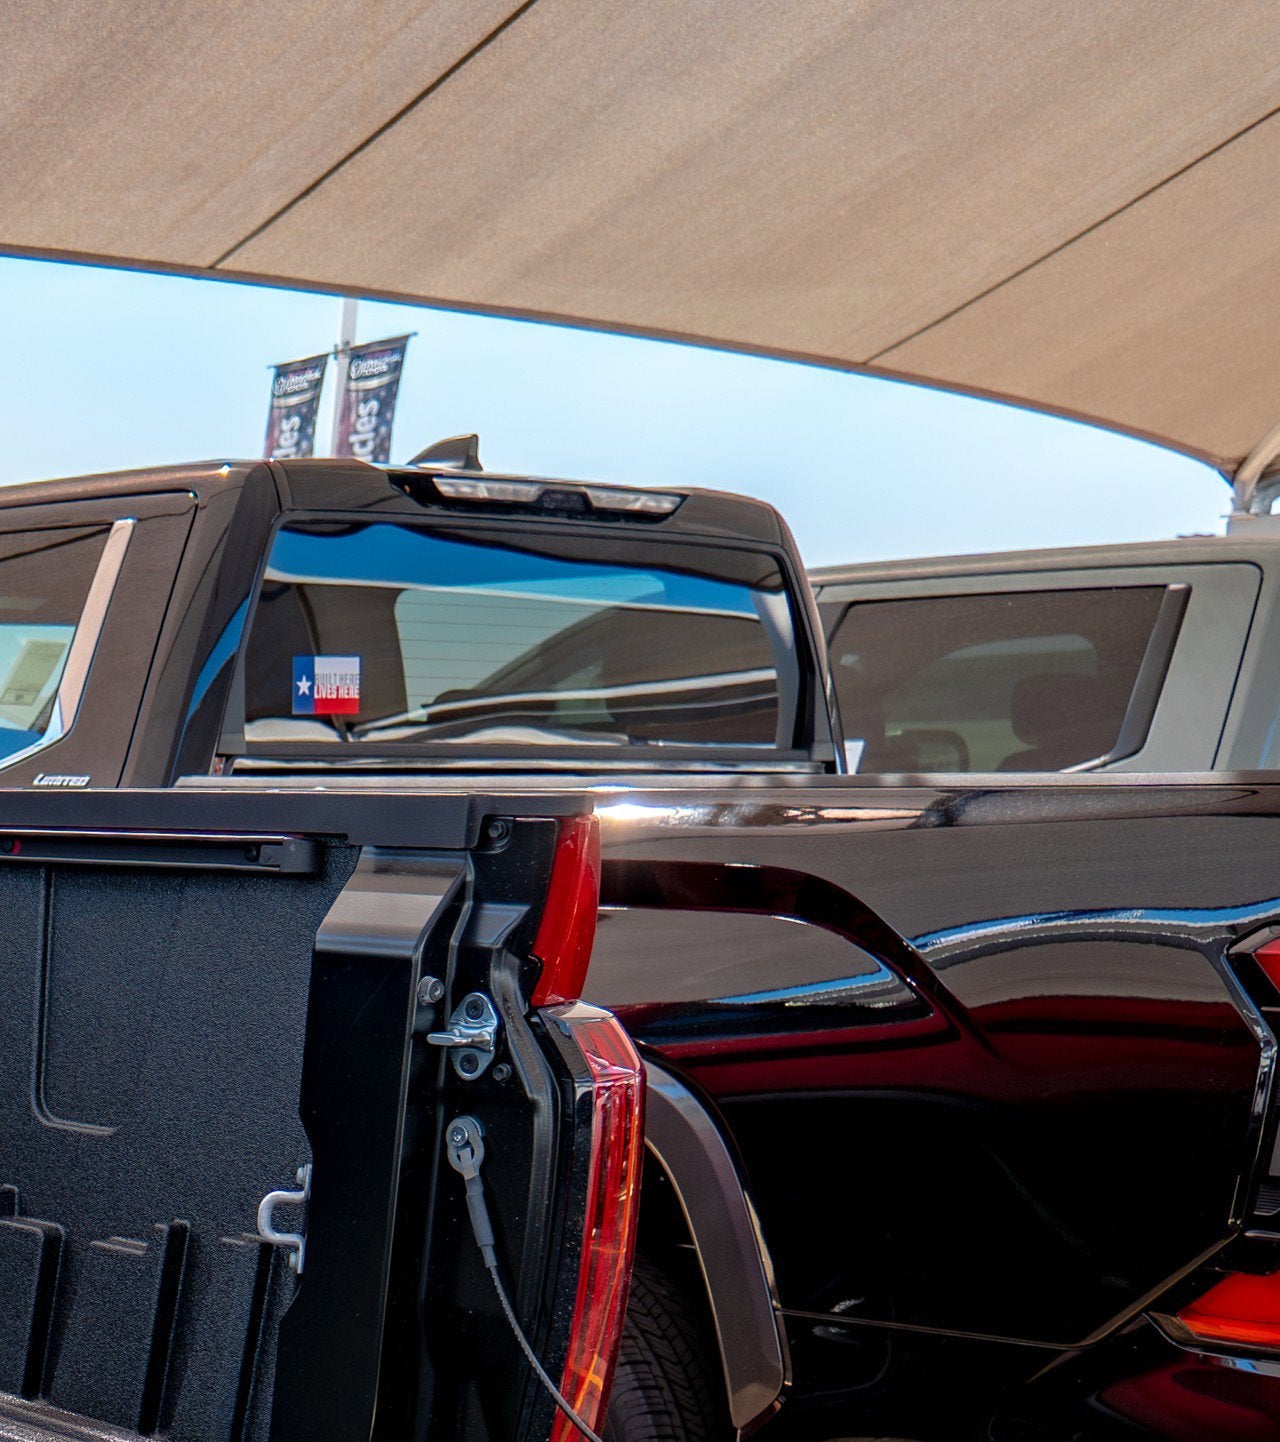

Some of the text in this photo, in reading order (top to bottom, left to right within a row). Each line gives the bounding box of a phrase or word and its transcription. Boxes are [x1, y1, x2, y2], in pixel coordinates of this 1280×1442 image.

[314, 673, 360, 686] BUILT HERE
[314, 685, 360, 699] LIVES HERE
